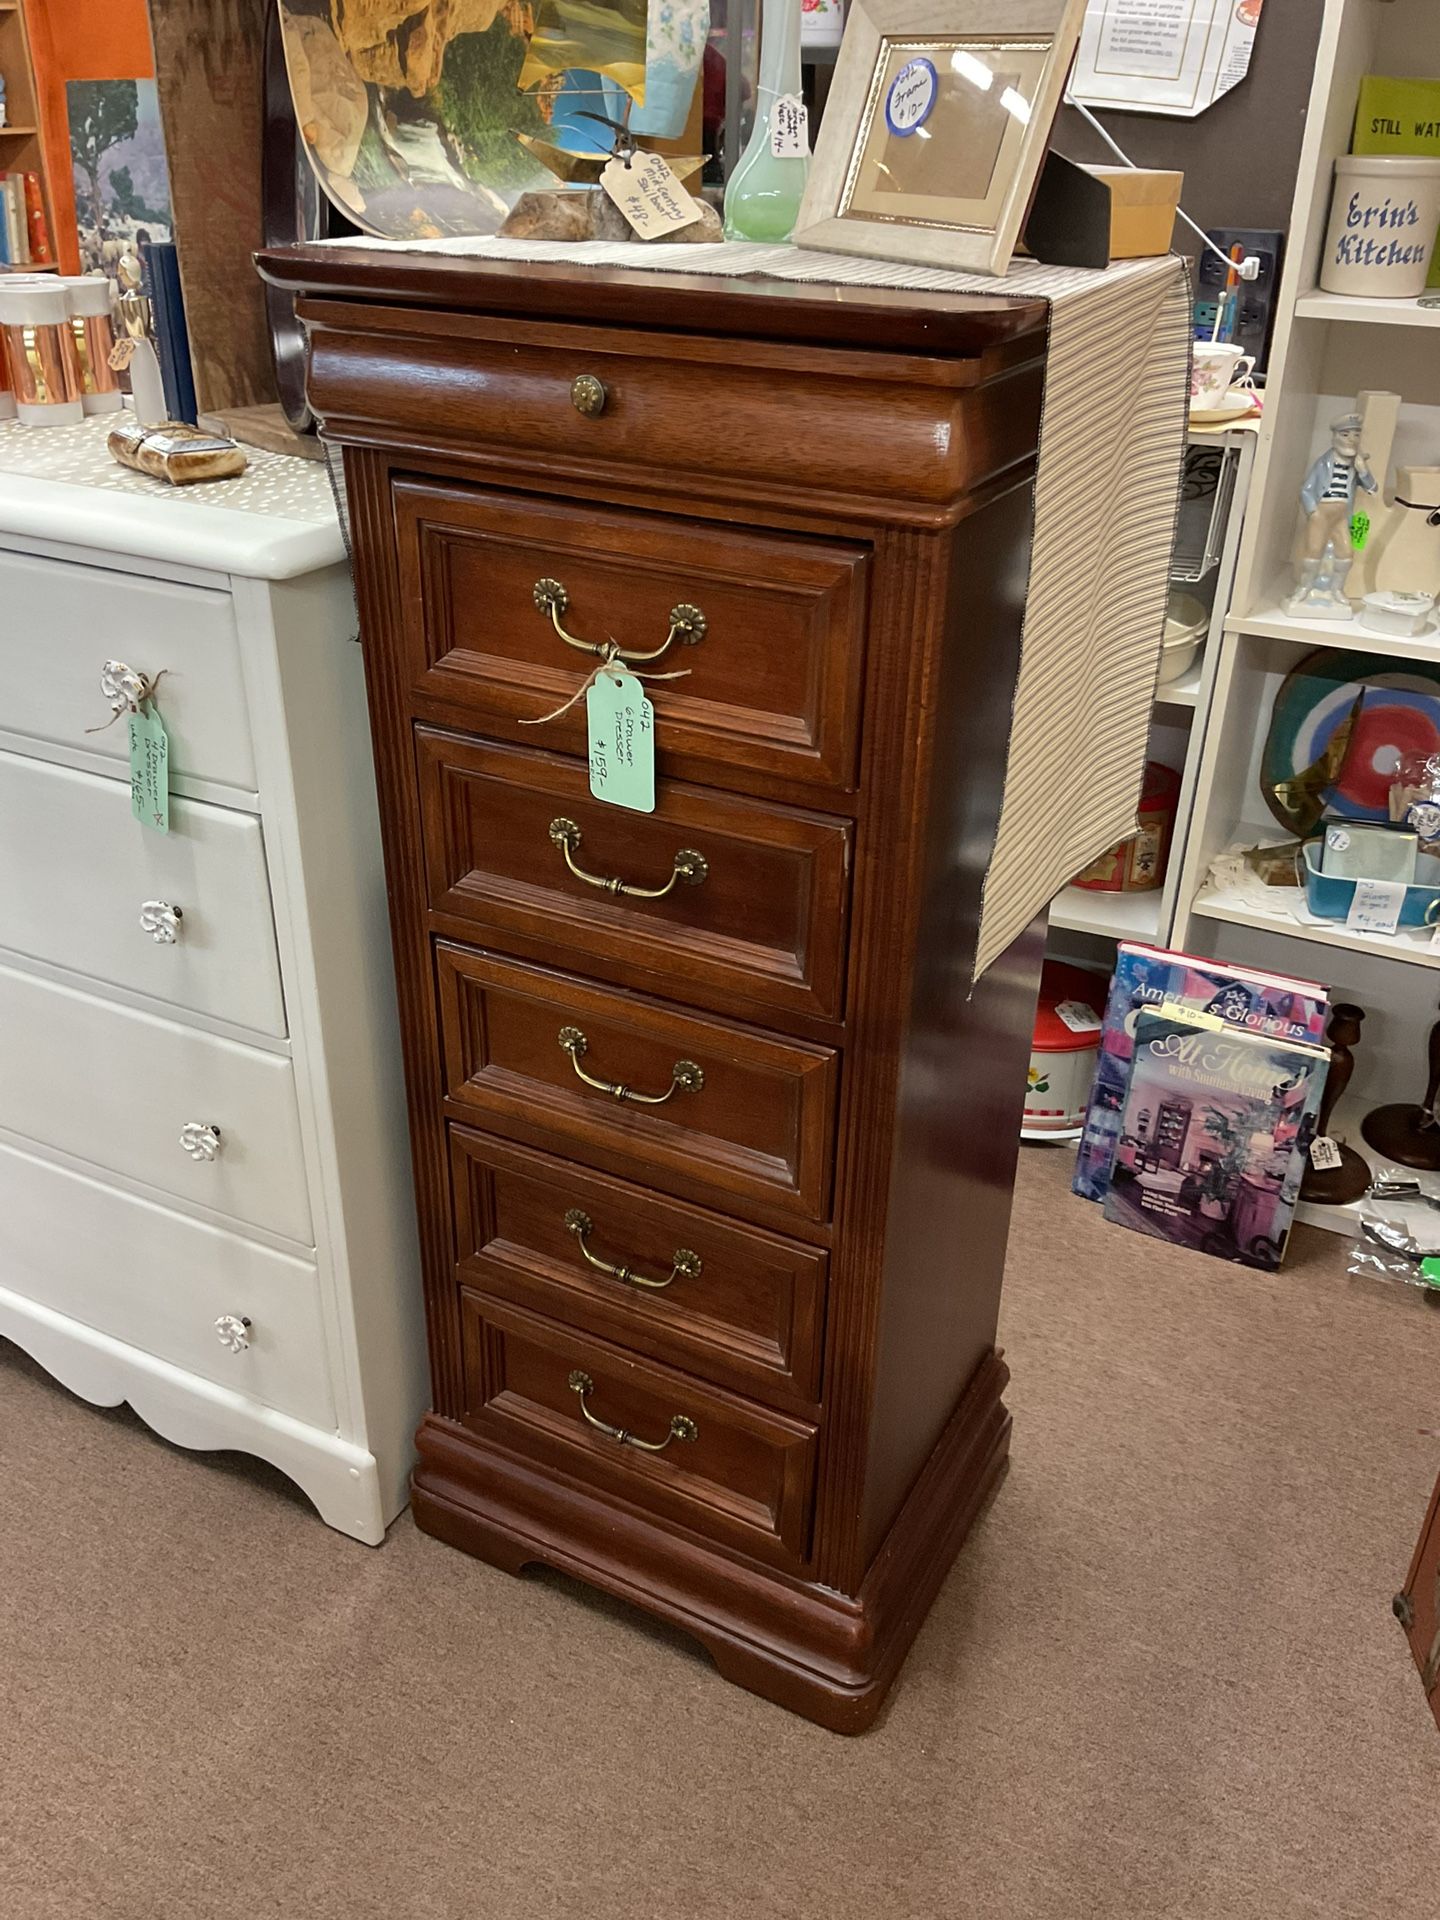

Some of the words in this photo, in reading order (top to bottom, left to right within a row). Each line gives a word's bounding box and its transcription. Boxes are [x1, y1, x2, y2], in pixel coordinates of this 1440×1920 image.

[1371, 118, 1402, 136] STILL
[650, 158, 671, 180] 042
[1346, 192, 1420, 229] Erin's
[1335, 234, 1425, 267] Kitchen
[625, 706, 634, 716] 6
[640, 701, 651, 732] 042
[615, 711, 625, 765] Dresser
[626, 719, 634, 767] Drawer
[144, 737, 152, 797] Dresser
[1226, 1004, 1306, 1037] Glorious
[1150, 1034, 1200, 1066] At
[1202, 1043, 1307, 1091] Home
[1168, 1063, 1192, 1079] with
